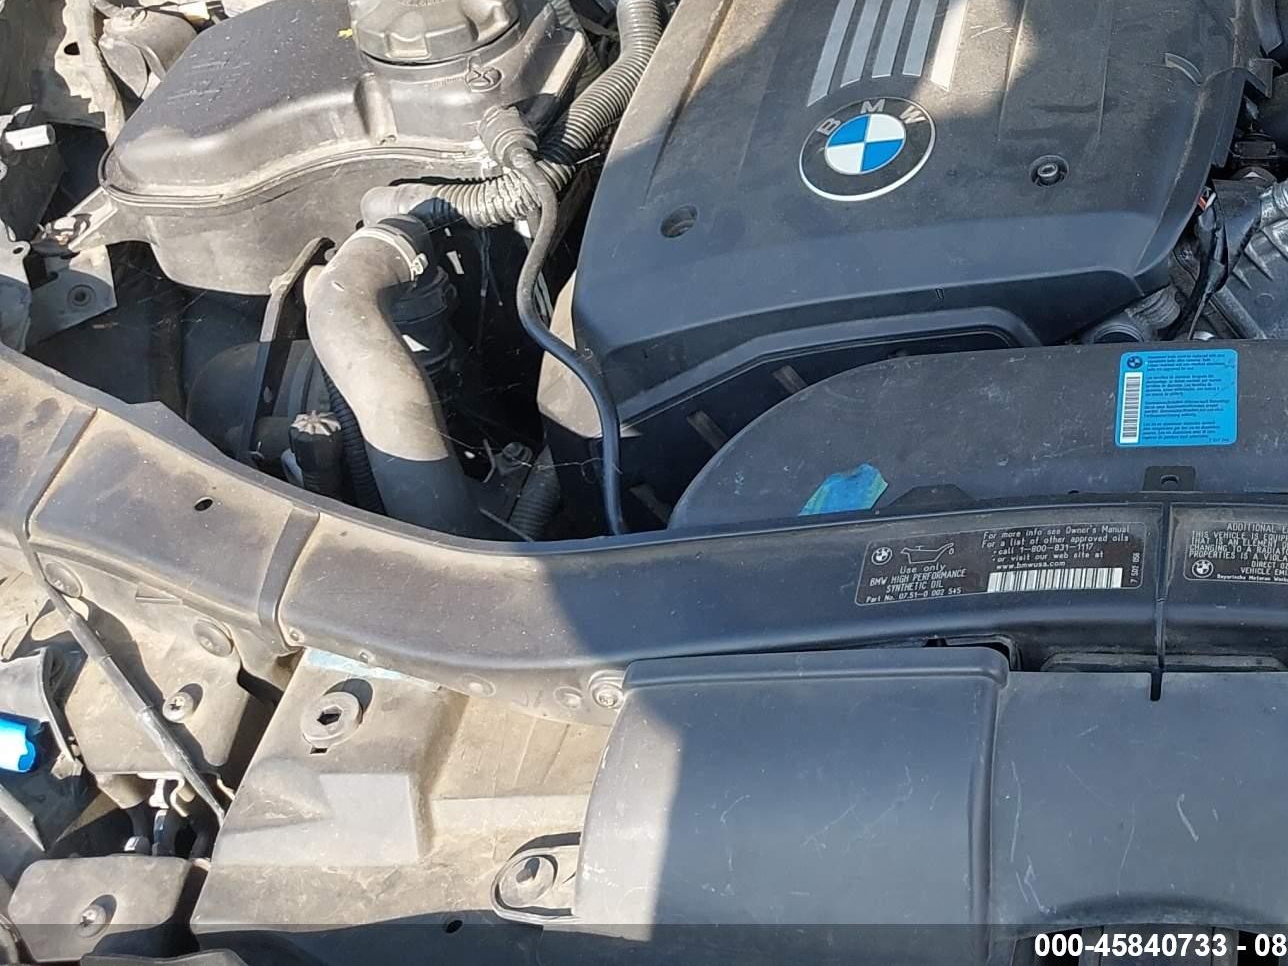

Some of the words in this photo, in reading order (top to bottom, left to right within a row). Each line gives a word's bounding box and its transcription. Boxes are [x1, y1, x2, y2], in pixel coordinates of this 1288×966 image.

[983, 531, 997, 539] For
[1026, 528, 1042, 536] info
[1065, 524, 1097, 534] Owner's
[1101, 525, 1130, 534] Manual
[1227, 523, 1276, 533] ADDITIONAL
[1192, 530, 1209, 539] THIS
[1213, 531, 1246, 539] VEHICLE
[981, 539, 996, 548] For
[1010, 537, 1025, 546] list
[1029, 537, 1039, 545] of
[1043, 535, 1066, 544] other
[1070, 534, 1107, 544] approved
[1112, 533, 1129, 542] oils
[1228, 538, 1239, 546] AN
[1243, 538, 1277, 547] ELEMENT
[998, 546, 1014, 555] call
[1020, 543, 1094, 554] 1-800-831-1117
[1190, 544, 1228, 552] CHANGING
[1233, 545, 1242, 553] TO
[1011, 553, 1030, 561] visit
[1073, 550, 1090, 559] site
[1094, 550, 1104, 558] at
[1189, 551, 1236, 560] PROPERTIES
[1240, 552, 1249, 560] IS
[1252, 553, 1259, 561] A
[900, 565, 917, 574] Use
[923, 562, 946, 573] only
[996, 561, 1066, 570] www.bmwusa.com
[1251, 560, 1276, 569] DIRECT
[1240, 566, 1271, 575] VEHICLE
[870, 576, 888, 586] BMW
[891, 573, 910, 584] HIGH
[913, 568, 967, 581] PERFORMANCE
[886, 581, 927, 594] SYNTHETIC
[930, 579, 944, 589] OIL
[866, 595, 881, 603] Part
